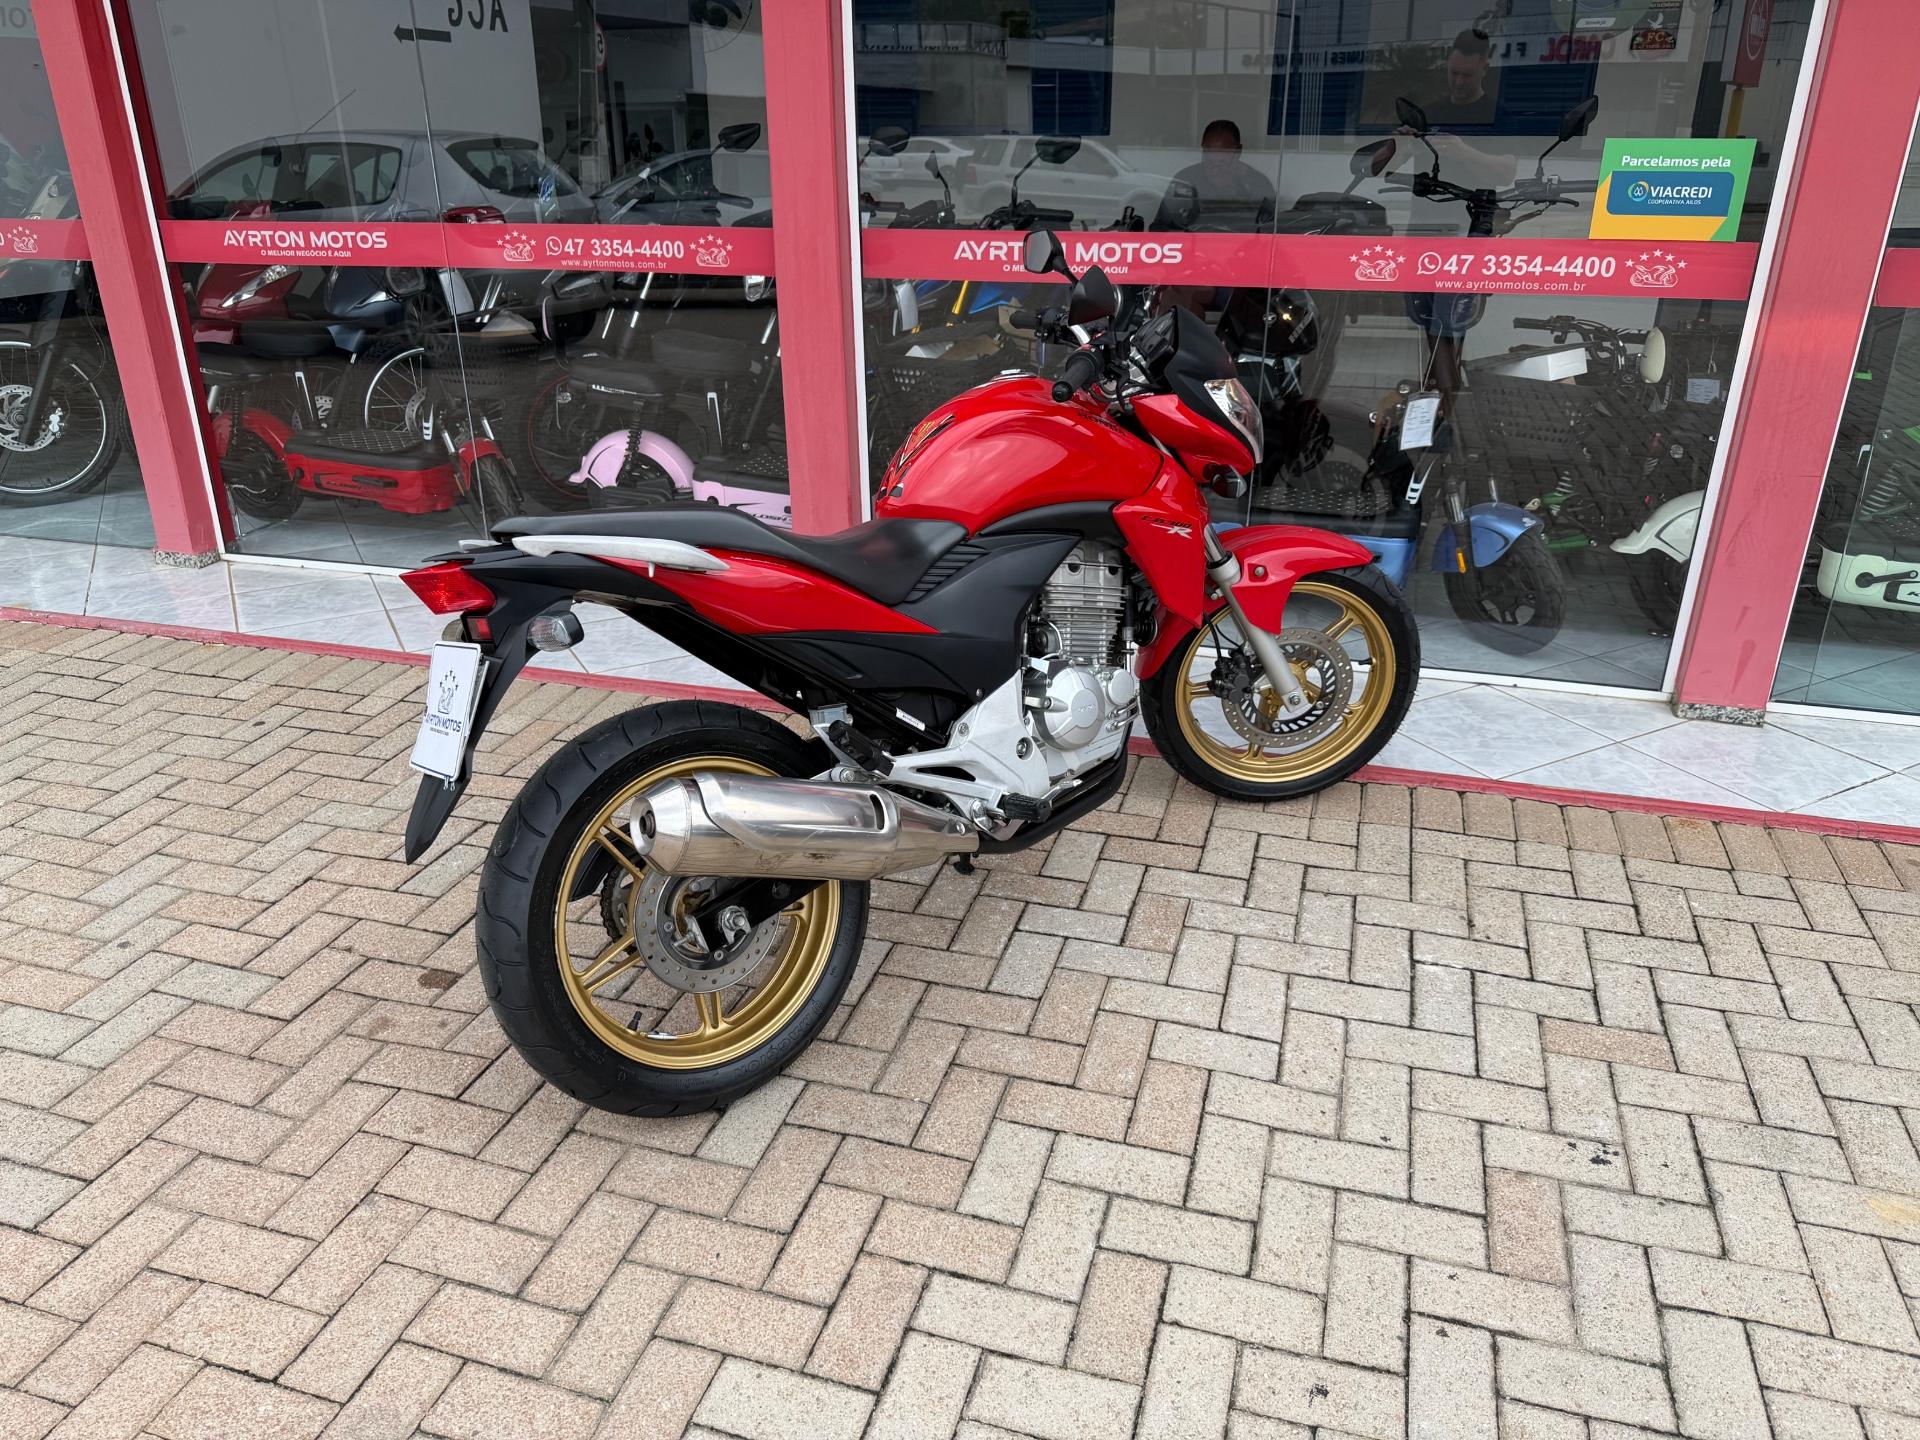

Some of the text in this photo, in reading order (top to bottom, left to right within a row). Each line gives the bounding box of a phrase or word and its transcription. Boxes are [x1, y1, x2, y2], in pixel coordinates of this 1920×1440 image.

[1621, 155, 1731, 170] Parcelamos pela
[1650, 186, 1713, 198] VIACREDI
[223, 230, 388, 249] AYRTON MOTOS
[267, 249, 295, 257] MELHOR
[296, 248, 327, 257] NEGÓCIO
[334, 250, 352, 258] AQUI
[564, 238, 685, 259] 47 3354-4400
[1075, 242, 1184, 264] MOTOS
[561, 258, 667, 270] www.ayrtonmotos.com.br
[1443, 255, 1616, 278] 47 3354-4400
[1434, 279, 1587, 292] www.ayrtonmotos.com.br
